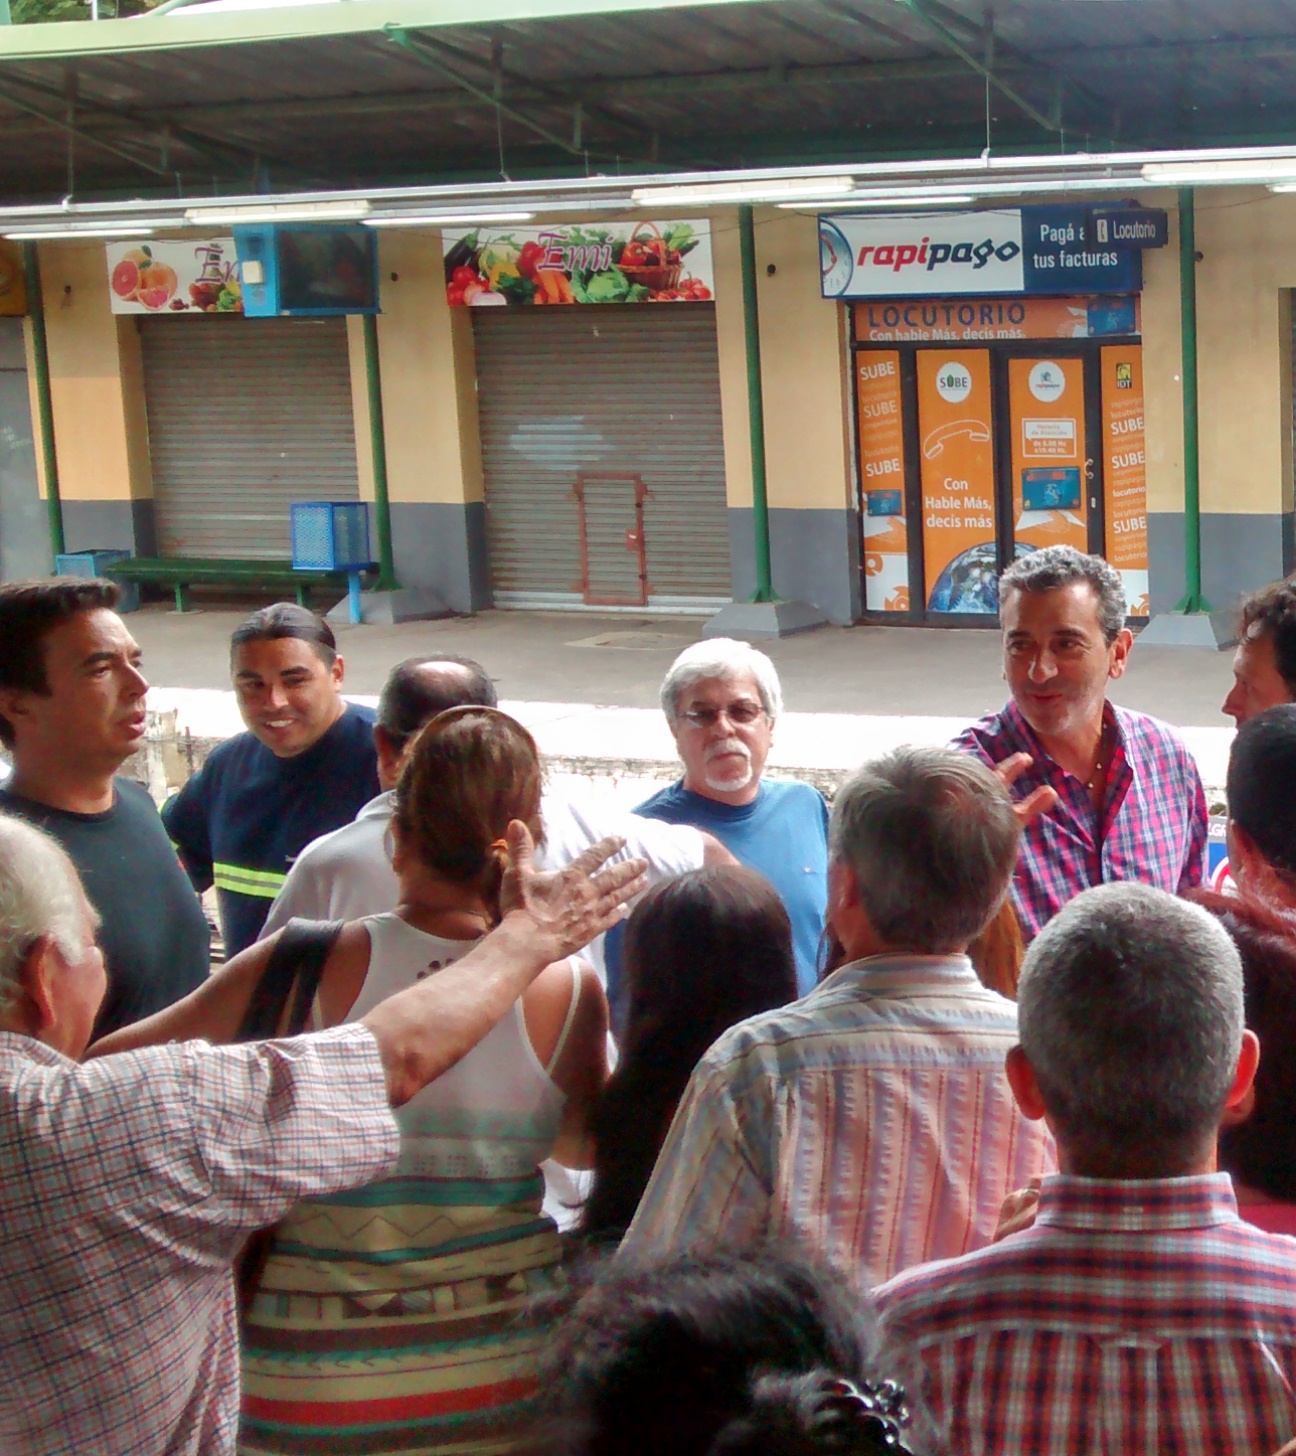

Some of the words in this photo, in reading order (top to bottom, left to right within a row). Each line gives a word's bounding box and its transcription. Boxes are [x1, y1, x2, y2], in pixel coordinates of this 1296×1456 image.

[1040, 222, 1075, 246] Pagá
[1113, 220, 1156, 239] Locutorio
[537, 232, 614, 271] Emi
[858, 238, 1020, 271] rapipago
[1033, 253, 1055, 269] tus
[1060, 251, 1118, 267] facturas
[868, 302, 1025, 327] LOCUTORIO
[869, 330, 892, 341] Con
[896, 329, 929, 341] hable
[860, 361, 895, 381] SUBE
[863, 400, 898, 418] SUBE
[1110, 417, 1145, 436] SUBE
[865, 458, 901, 477] SUBE
[1111, 451, 1145, 469] SUBE
[943, 478, 968, 490] Con
[925, 497, 961, 509] Hable
[964, 496, 992, 511] Más,
[964, 515, 992, 528] más
[1113, 516, 1147, 534] SUBE
